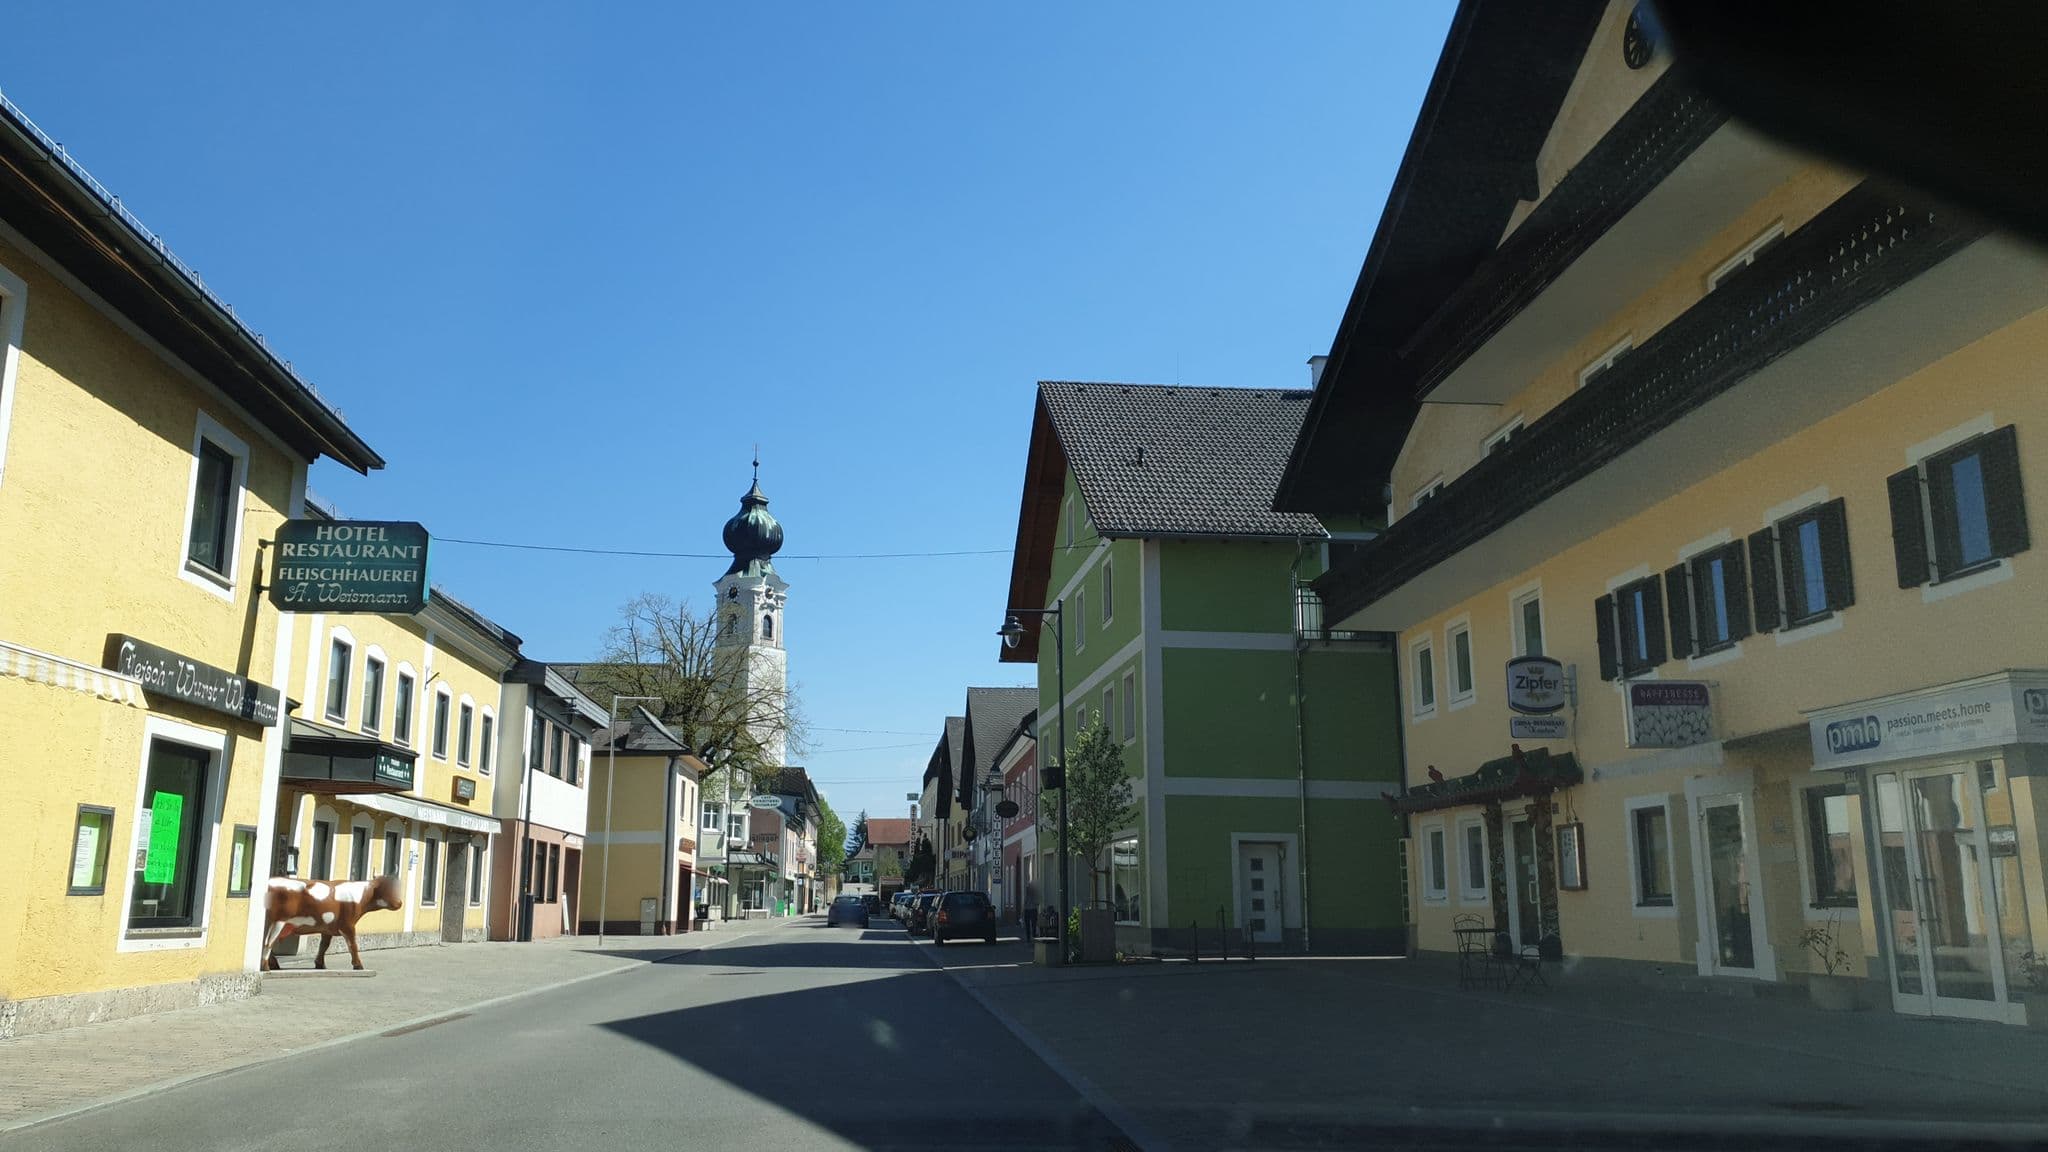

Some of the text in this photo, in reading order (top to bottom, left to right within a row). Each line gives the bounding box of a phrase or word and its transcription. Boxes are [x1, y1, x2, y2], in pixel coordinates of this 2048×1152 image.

[315, 525, 389, 542] HOTEL
[281, 543, 422, 559] RESTAURANT
[278, 567, 418, 582] FLEISCHHAUEREI
[317, 582, 409, 605] Weismann
[1515, 676, 1558, 692] Zipfer
[1887, 702, 1991, 732] passion.meets.home
[1828, 718, 1879, 752] pmh
